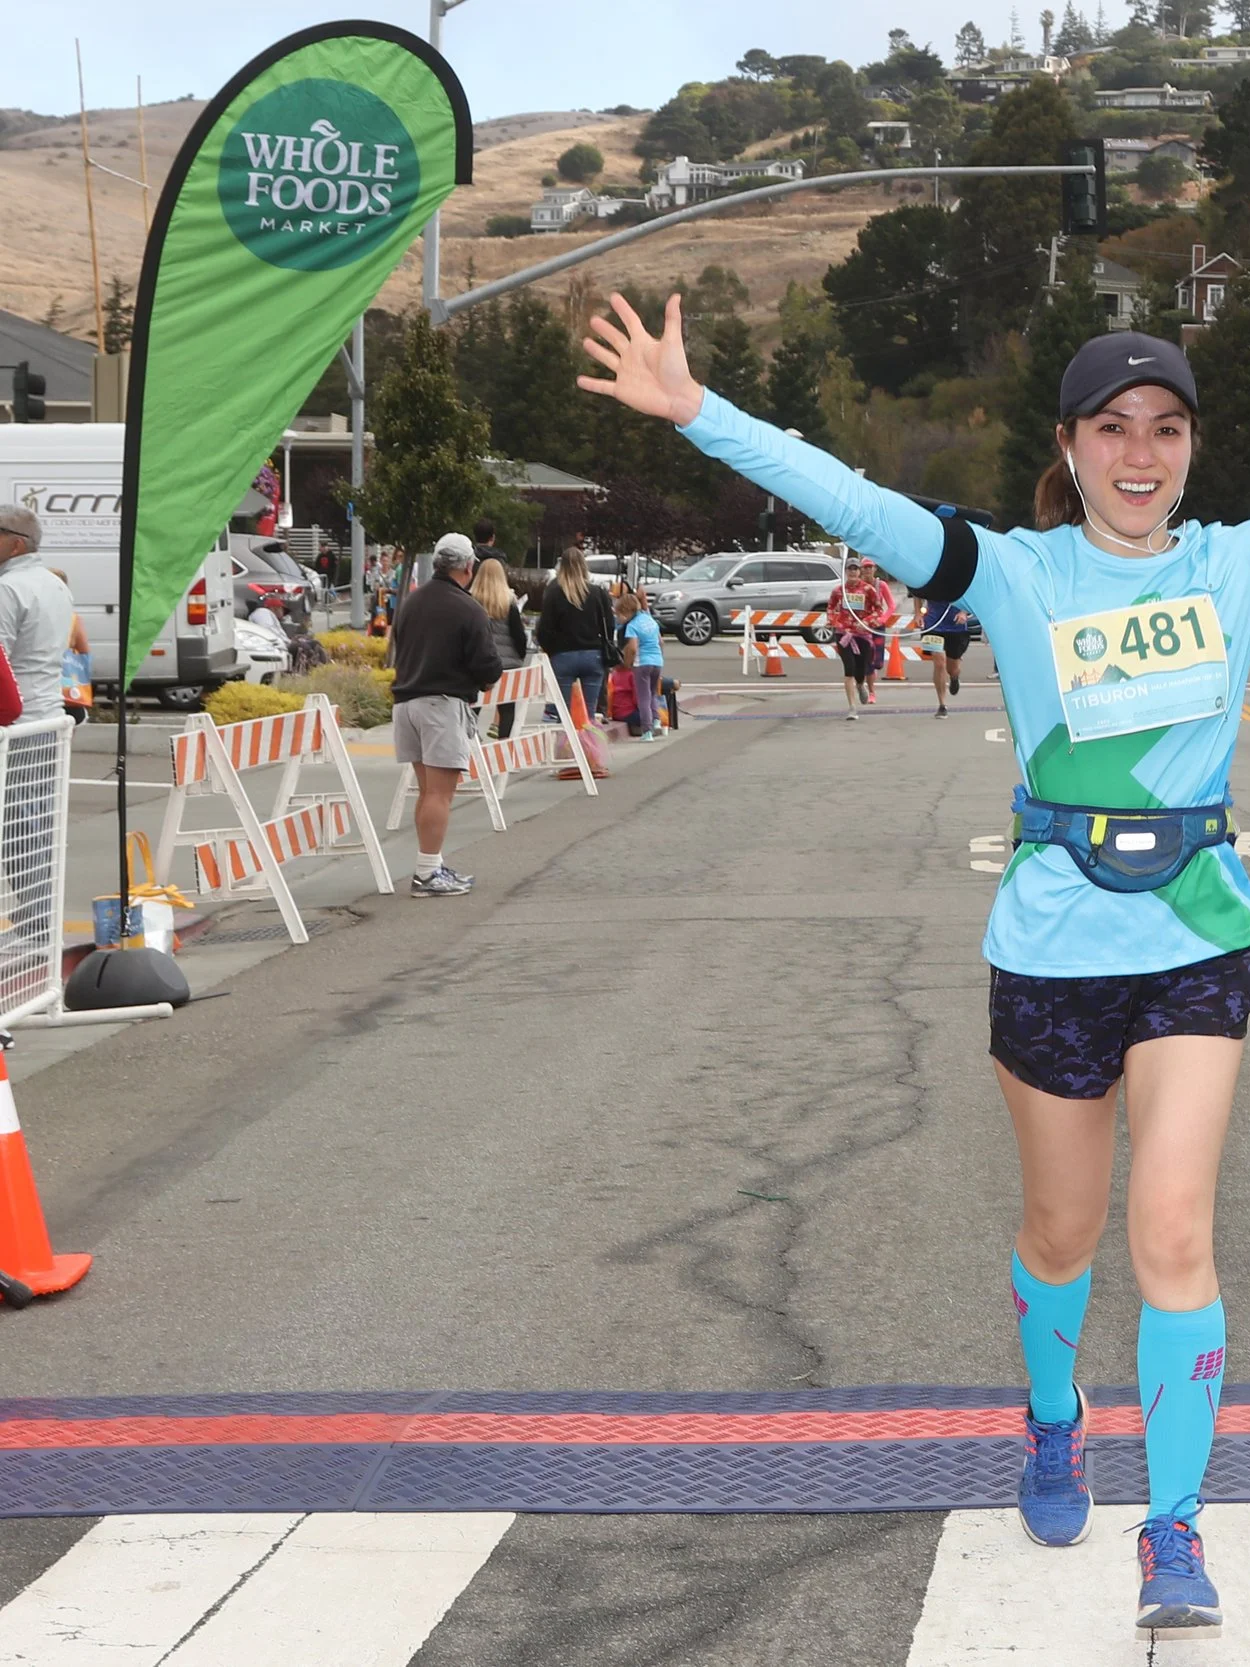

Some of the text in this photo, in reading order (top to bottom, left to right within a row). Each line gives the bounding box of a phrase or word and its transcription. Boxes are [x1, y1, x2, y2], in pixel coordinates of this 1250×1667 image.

[241, 128, 400, 180] WHOLE
[244, 172, 394, 216] FOODS
[260, 217, 366, 235] MARKET
[1120, 606, 1206, 661] 481
[1071, 682, 1149, 710] TIBURON
